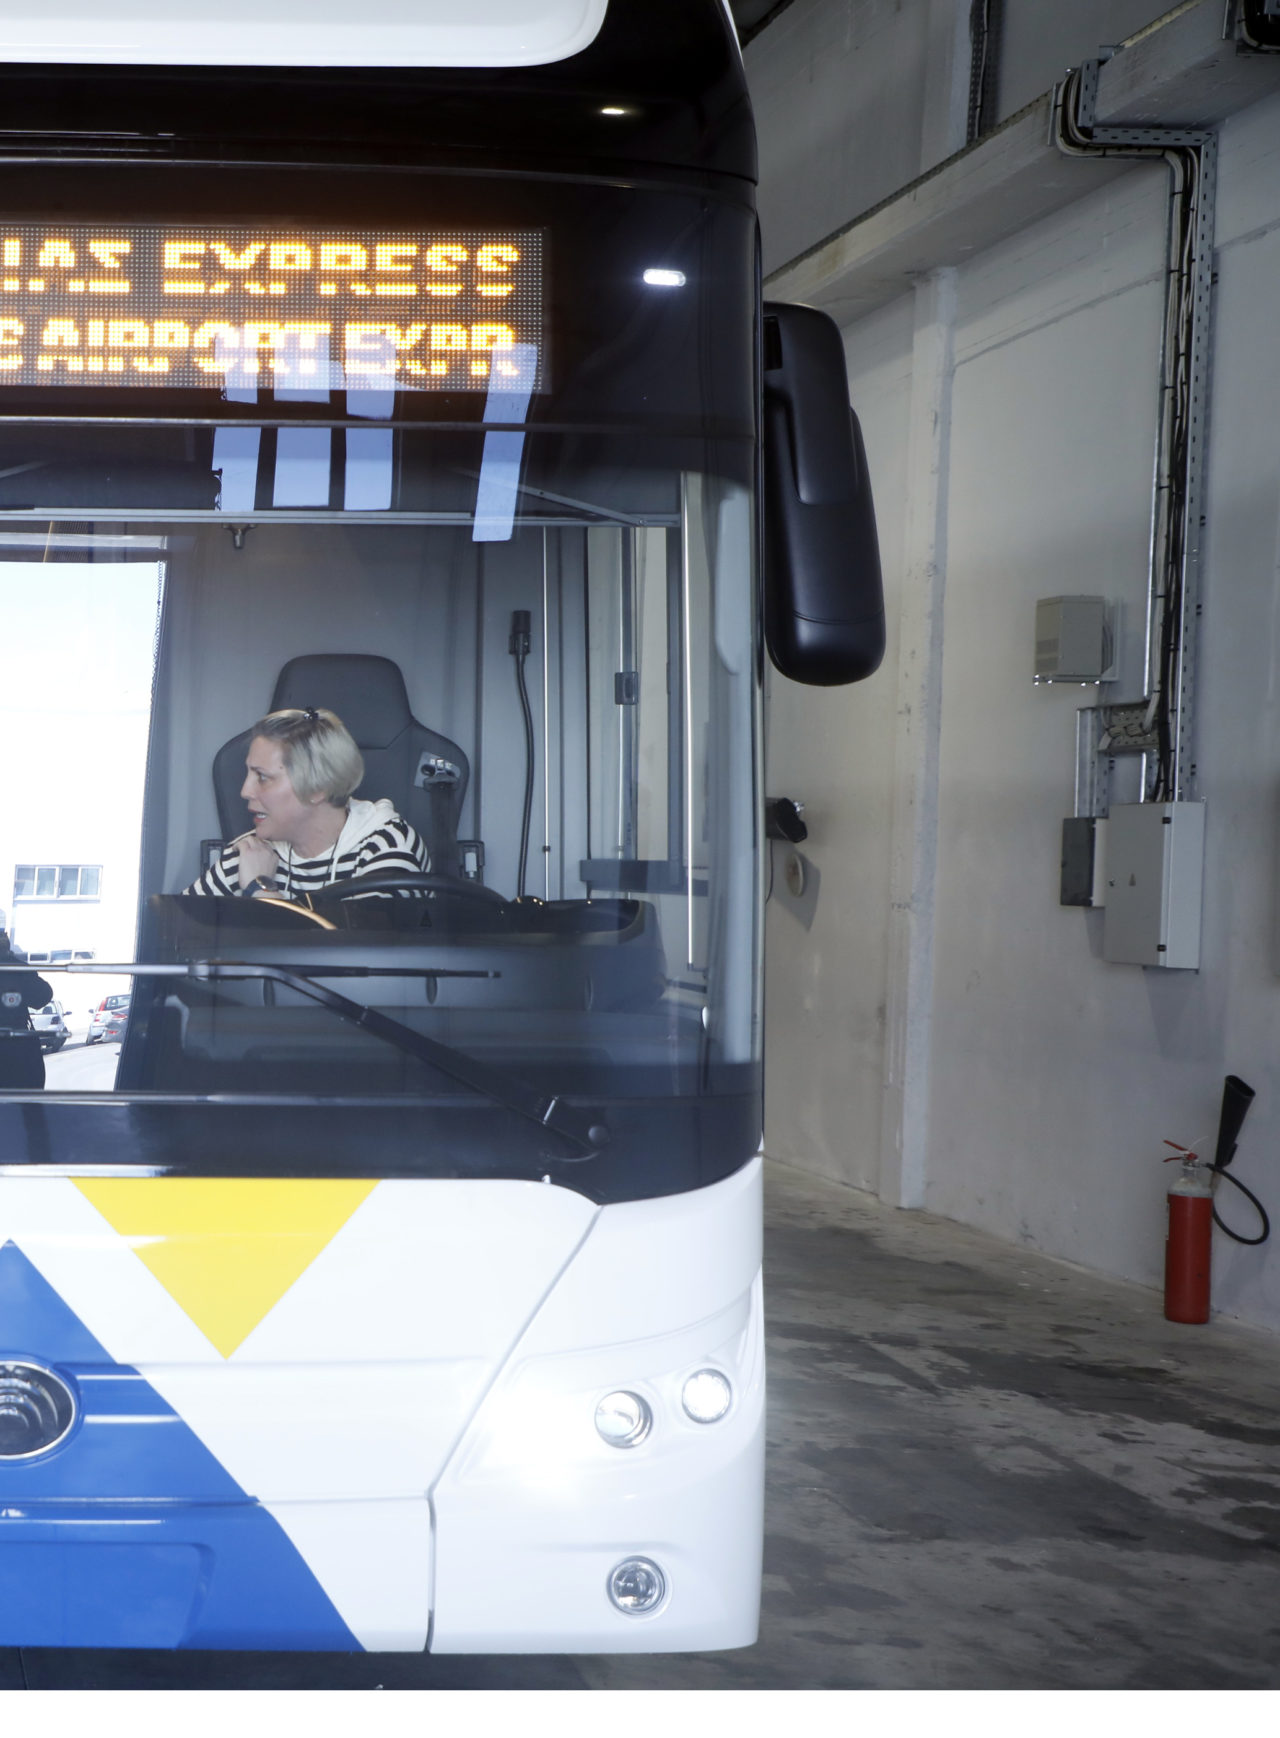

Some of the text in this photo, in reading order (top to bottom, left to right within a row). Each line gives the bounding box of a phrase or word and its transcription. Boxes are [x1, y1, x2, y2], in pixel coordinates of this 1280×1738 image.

[163, 241, 521, 298] EXPRESS
[37, 317, 332, 375] AIRPORT
[344, 322, 520, 377] EXPR
